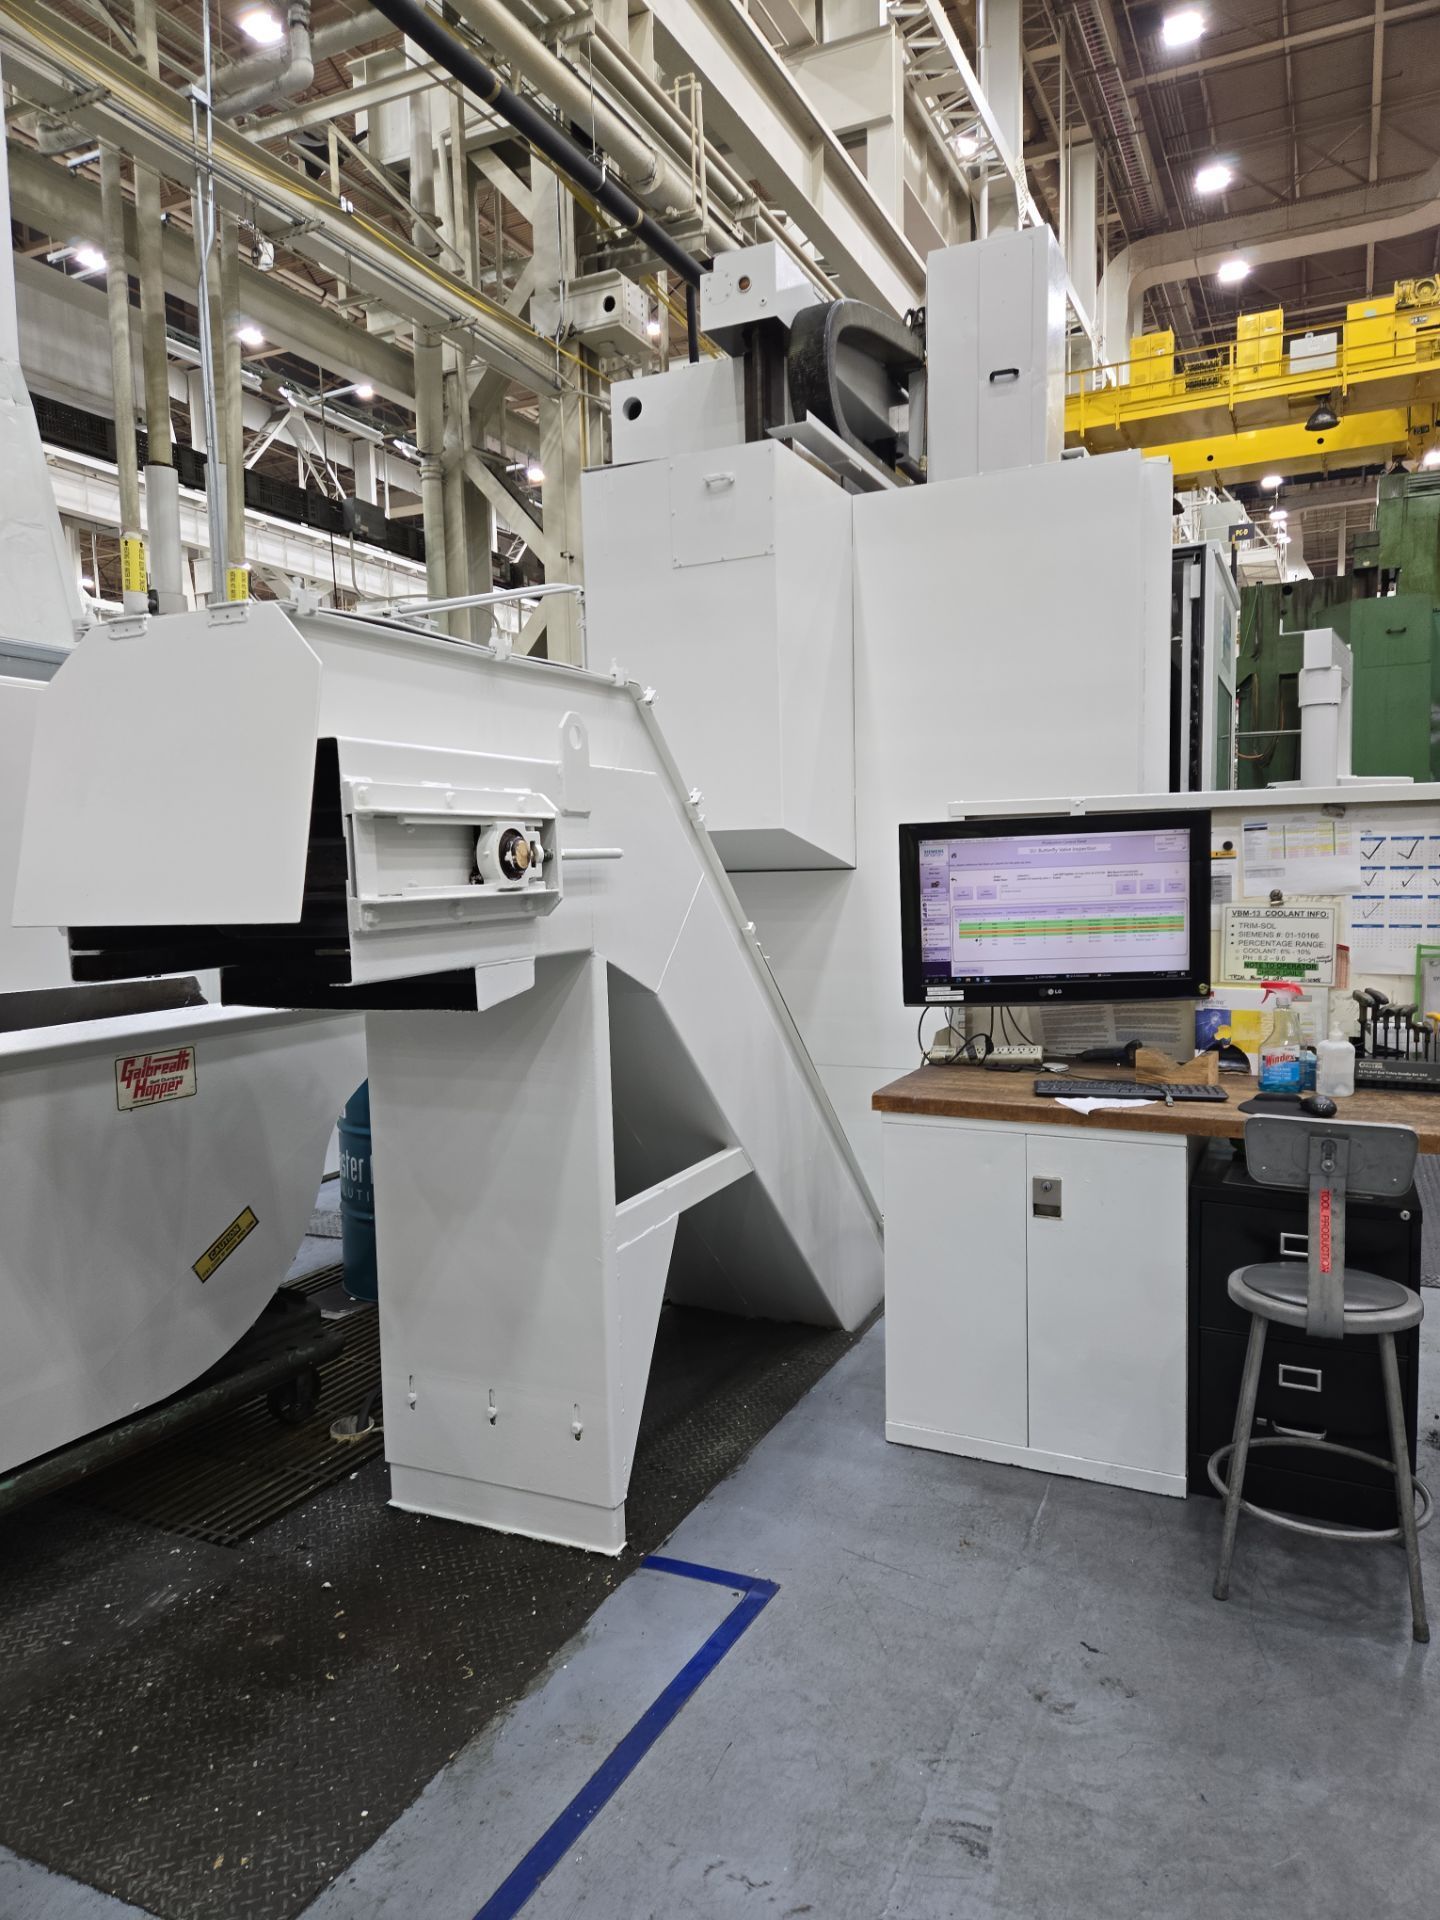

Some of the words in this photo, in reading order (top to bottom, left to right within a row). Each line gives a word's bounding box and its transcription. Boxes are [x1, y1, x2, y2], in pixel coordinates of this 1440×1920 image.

[1231, 910, 1261, 918] VBM-13
[1265, 910, 1305, 918] COOLANT
[1307, 910, 1329, 919] INFO:
[1238, 939, 1293, 947] PERCENTAGE
[120, 1050, 190, 1089] Galbreath
[1265, 1053, 1296, 1067] Windex
[132, 1078, 184, 1101] Hopper
[1320, 1190, 1330, 1213] TOOL
[209, 1224, 241, 1259] CAUTION
[1320, 1214, 1330, 1273] PRODUCTION
